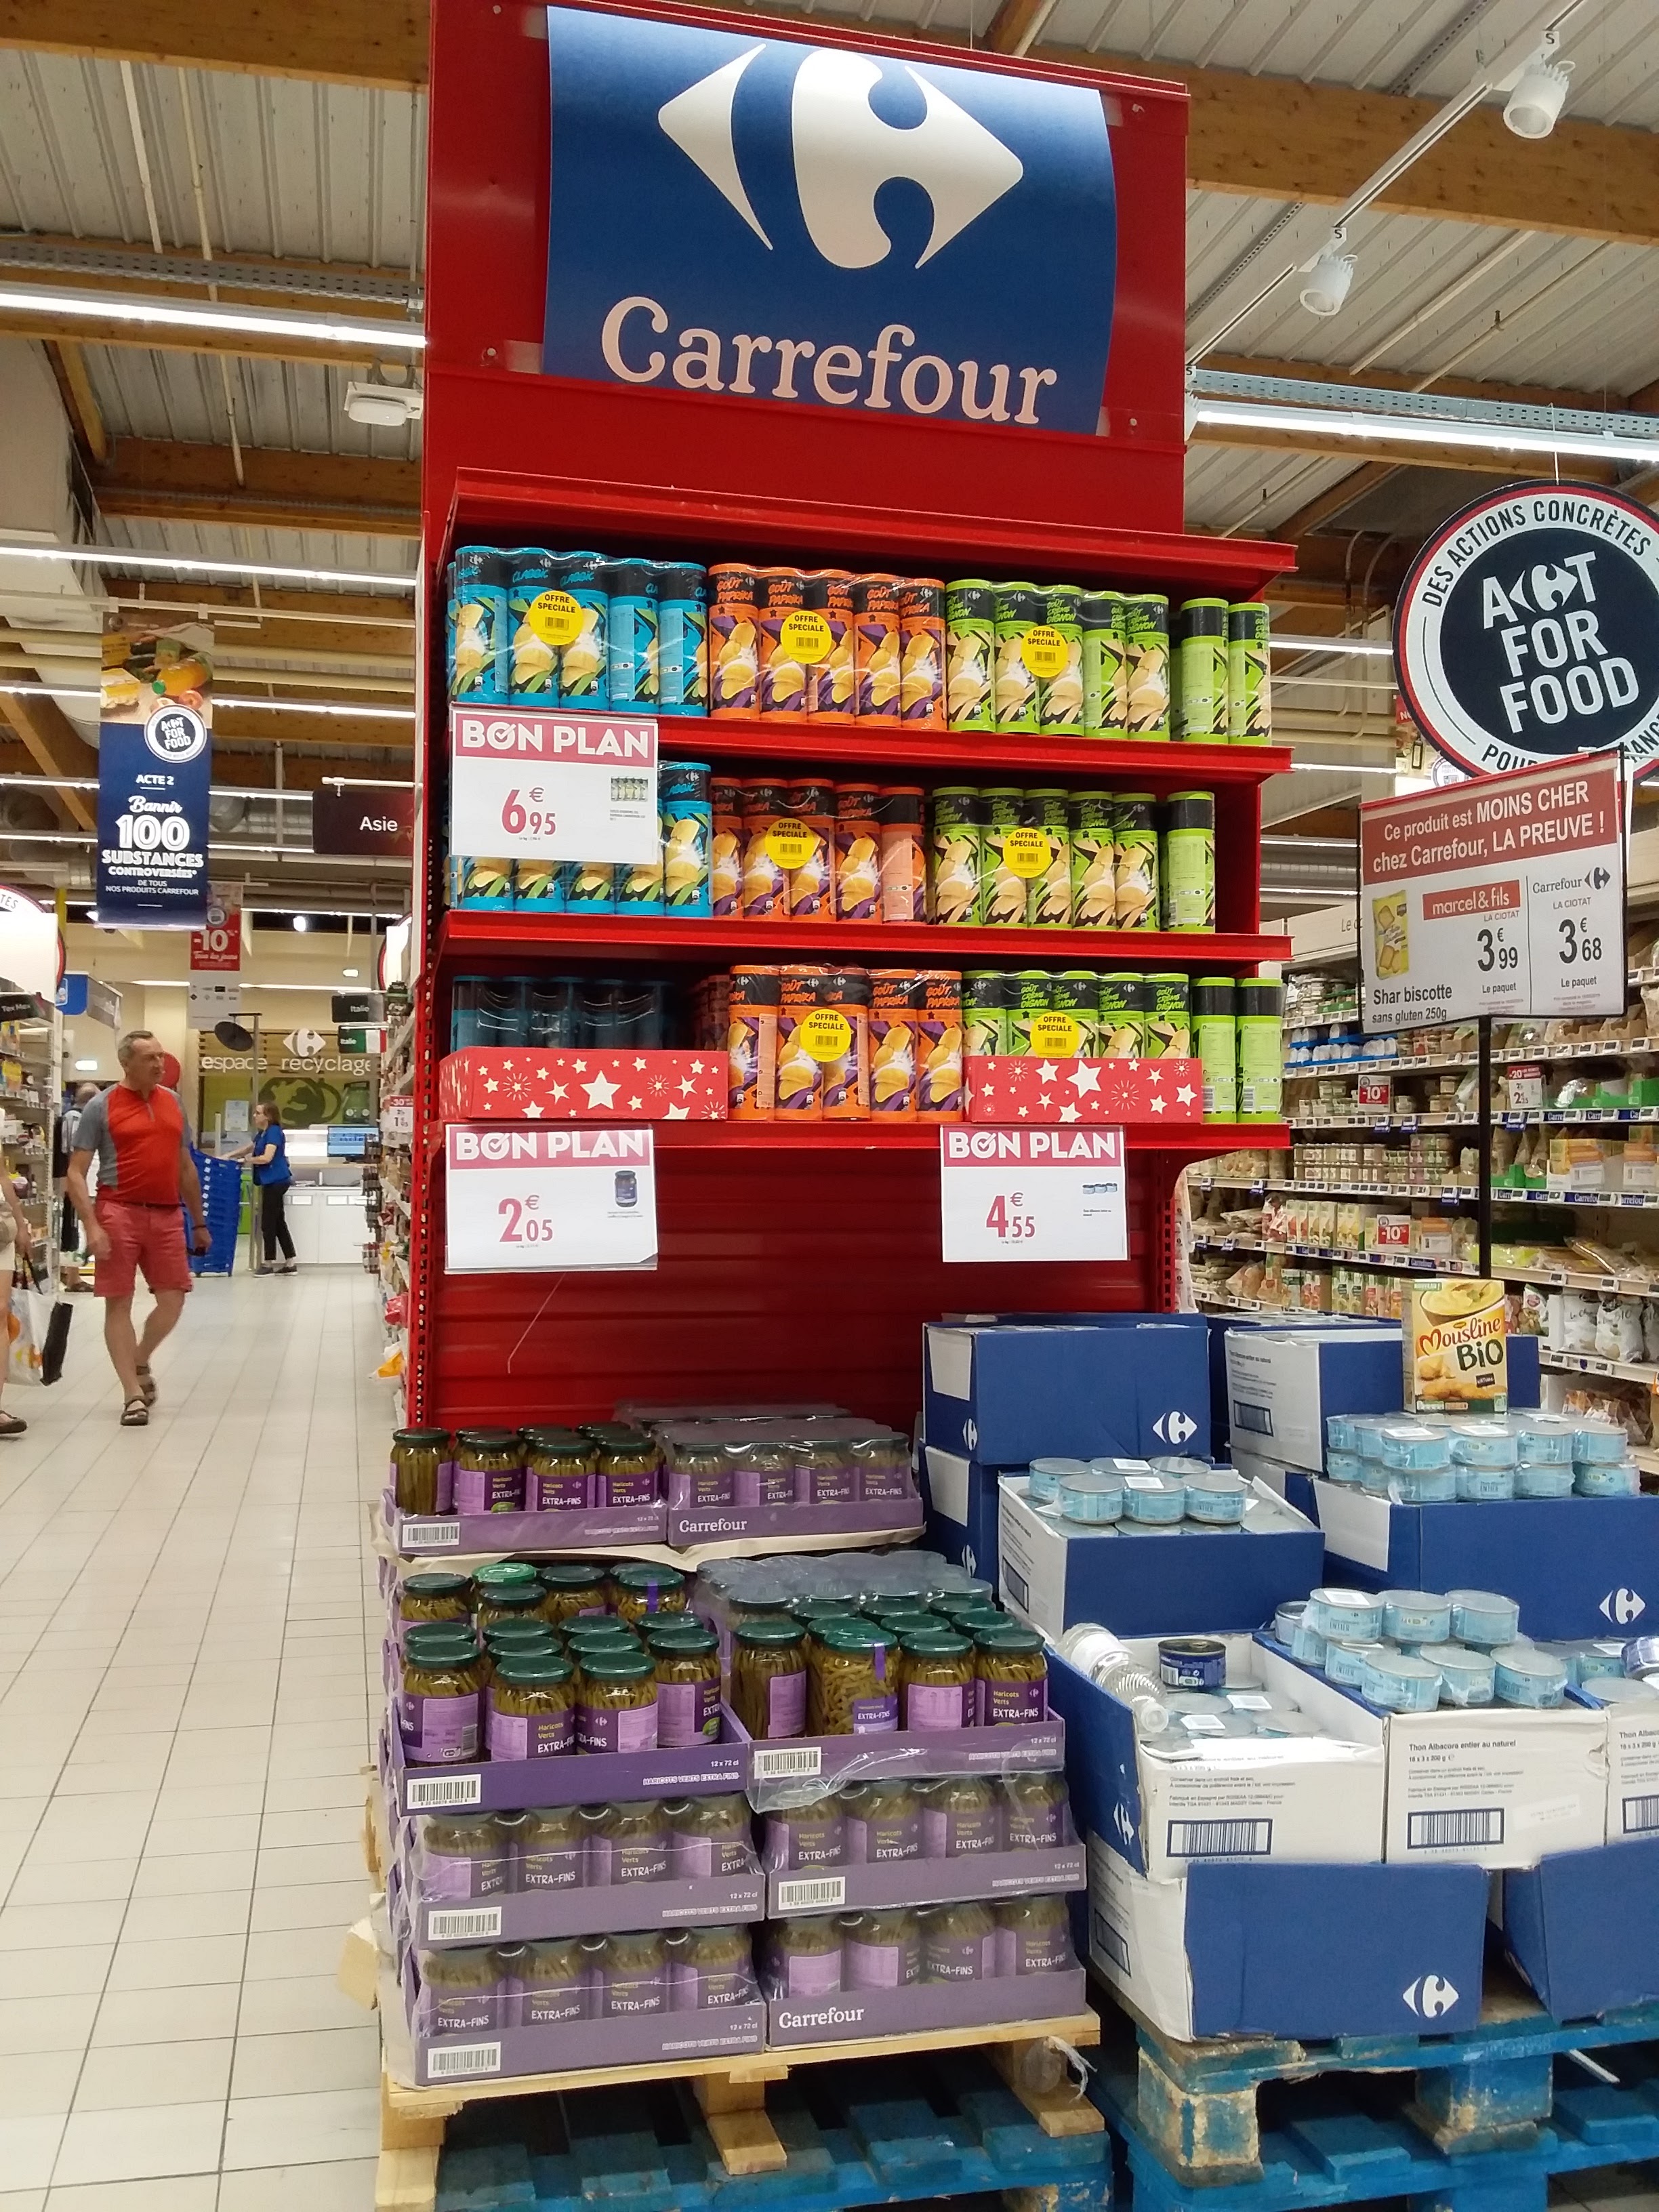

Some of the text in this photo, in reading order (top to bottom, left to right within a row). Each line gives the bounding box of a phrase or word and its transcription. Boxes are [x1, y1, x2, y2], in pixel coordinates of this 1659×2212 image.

[601, 295, 1058, 424] Carrefour
[1422, 499, 1652, 608] DES ACTIONS CONCRÈTES
[544, 594, 570, 603] OFFRE
[538, 602, 576, 613] SPECIALE
[789, 623, 824, 632] SPECIALE
[1500, 610, 1608, 678] FOR
[1500, 657, 1639, 734] FOOD
[165, 727, 185, 739] FOR
[462, 719, 649, 758] BON PLAN
[164, 736, 191, 750] FOOD
[136, 774, 174, 785] ACTE 2
[128, 796, 182, 813] Bannir
[501, 789, 527, 834] 6
[530, 813, 556, 835] 95
[1385, 781, 1589, 841] Ce produit est MOINS CHER
[359, 816, 398, 831] Asie
[115, 815, 190, 851] 100
[1373, 811, 1605, 873] chez Carrefour, LA PREUVE !
[102, 850, 203, 867] SUBSTANCES
[158, 887, 199, 895] CARREFOUR
[1532, 878, 1582, 895] Carrefour
[1553, 897, 1591, 909] LA CIOTAT
[1483, 911, 1519, 922] LA CIOTAT
[1559, 919, 1578, 964] 3
[1582, 937, 1601, 962] 68
[1477, 928, 1495, 972] 3
[1499, 947, 1519, 970] 99
[1482, 983, 1517, 995] Le paquet
[1561, 976, 1597, 989] Le paquet
[1373, 985, 1452, 1005] Shar biscotte
[1372, 1008, 1447, 1024] sans gluten 250g
[809, 1022, 844, 1030] SPECIALE
[202, 1056, 371, 1076] espace recyclage
[455, 1130, 644, 1160] BON PLAN
[949, 1131, 1117, 1159] BON PLAN
[497, 1197, 523, 1243] 2
[526, 1220, 553, 1243] 05
[985, 1195, 1010, 1238] 4
[1012, 1216, 1036, 1238] 55
[1419, 1317, 1500, 1357] Mousline
[613, 1494, 651, 1504] EXTRA-FINS
[865, 1488, 903, 1496] EXTRA-FINS
[542, 1496, 581, 1506] EXTRA-FINS
[679, 1518, 747, 1533] Carrefour
[993, 1708, 1039, 1718] EXTRA-FINS
[1409, 1743, 1426, 1751] Thon
[1010, 1832, 1057, 1843] EXTRA-FINS
[798, 1845, 841, 1860] EXTRA-FINS
[876, 1843, 918, 1858] EXTRA-FINS
[621, 1860, 667, 1877] EXTRA-FINS
[526, 1871, 575, 1884] EXTRA-FINS
[611, 1996, 660, 2011] EXTRA-FINS
[532, 2005, 580, 2020] EXTRA-FINS
[779, 2007, 864, 2028] Carrefour
[438, 2015, 489, 2028] EXTRA-FINS
